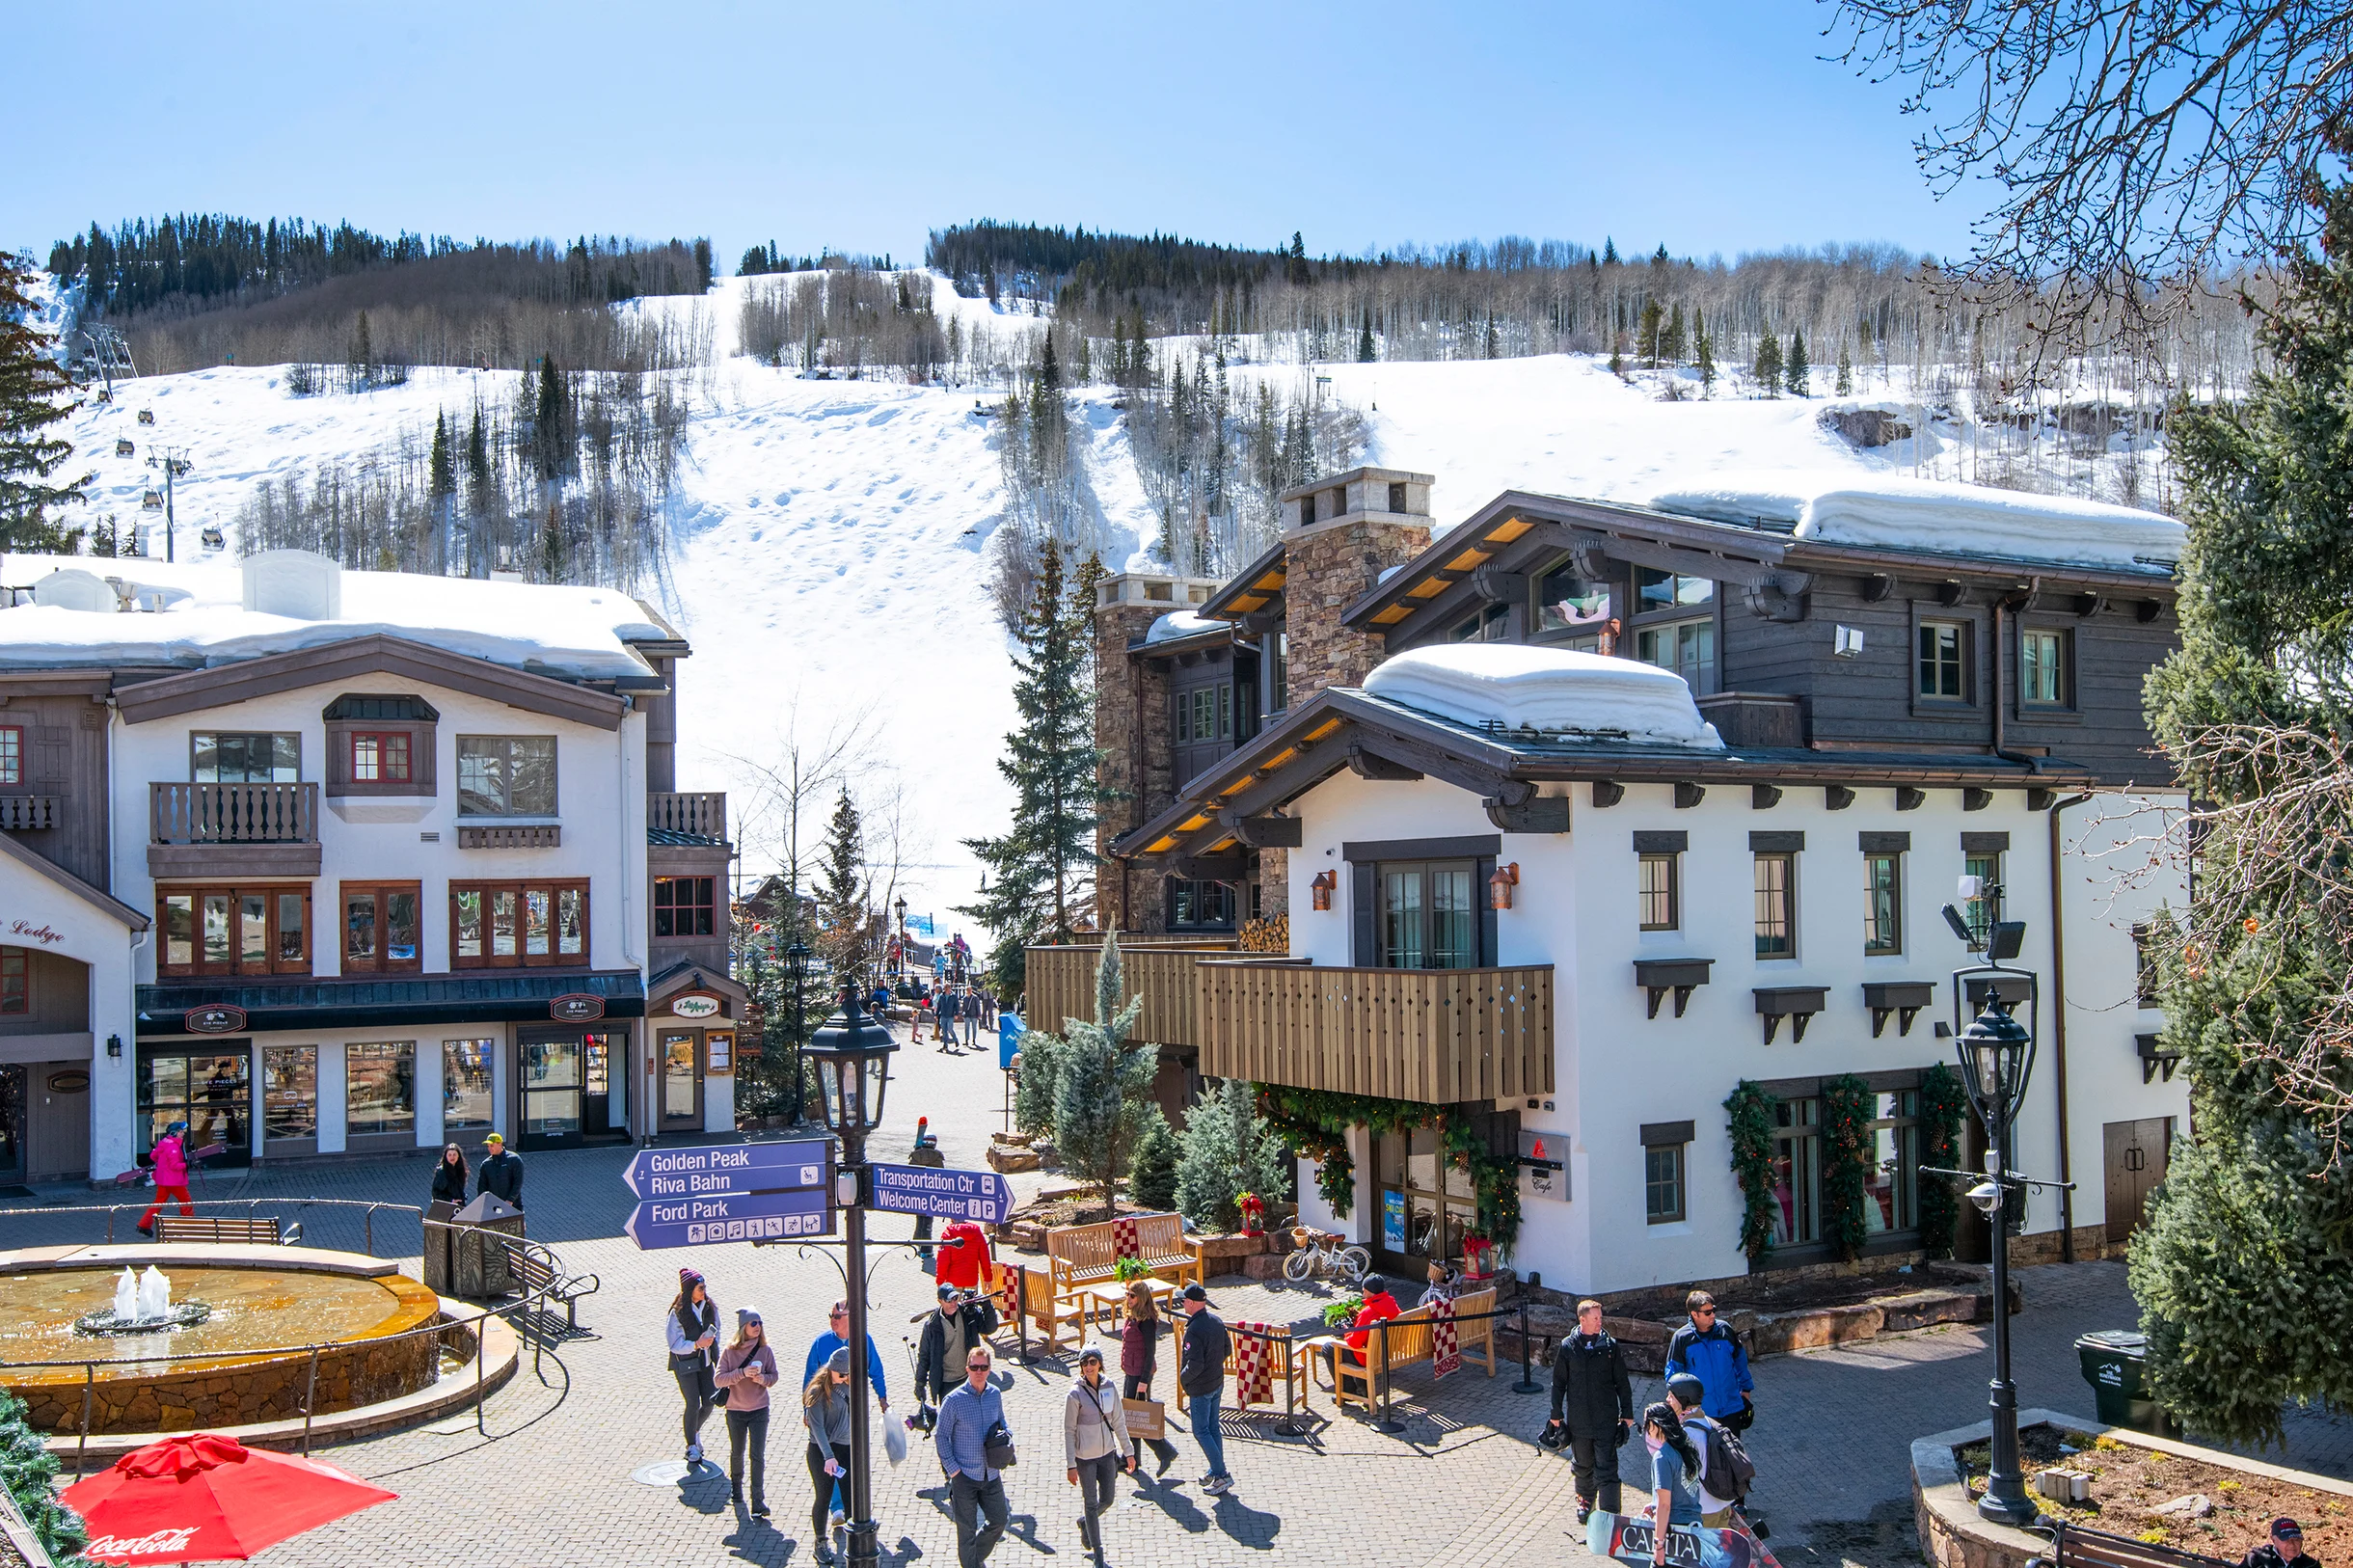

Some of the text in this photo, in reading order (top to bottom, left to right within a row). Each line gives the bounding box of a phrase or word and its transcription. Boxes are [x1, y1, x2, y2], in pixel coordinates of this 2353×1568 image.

[9, 919, 66, 945] Lodge
[651, 1149, 749, 1173] Golden Peak
[652, 1174, 731, 1194] Riva Bahn
[878, 1168, 975, 1193] Transportation Ctr
[652, 1200, 729, 1222] Ford Park
[879, 1189, 966, 1215] Welcome Center
[83, 1527, 201, 1558] Coca-Cola
